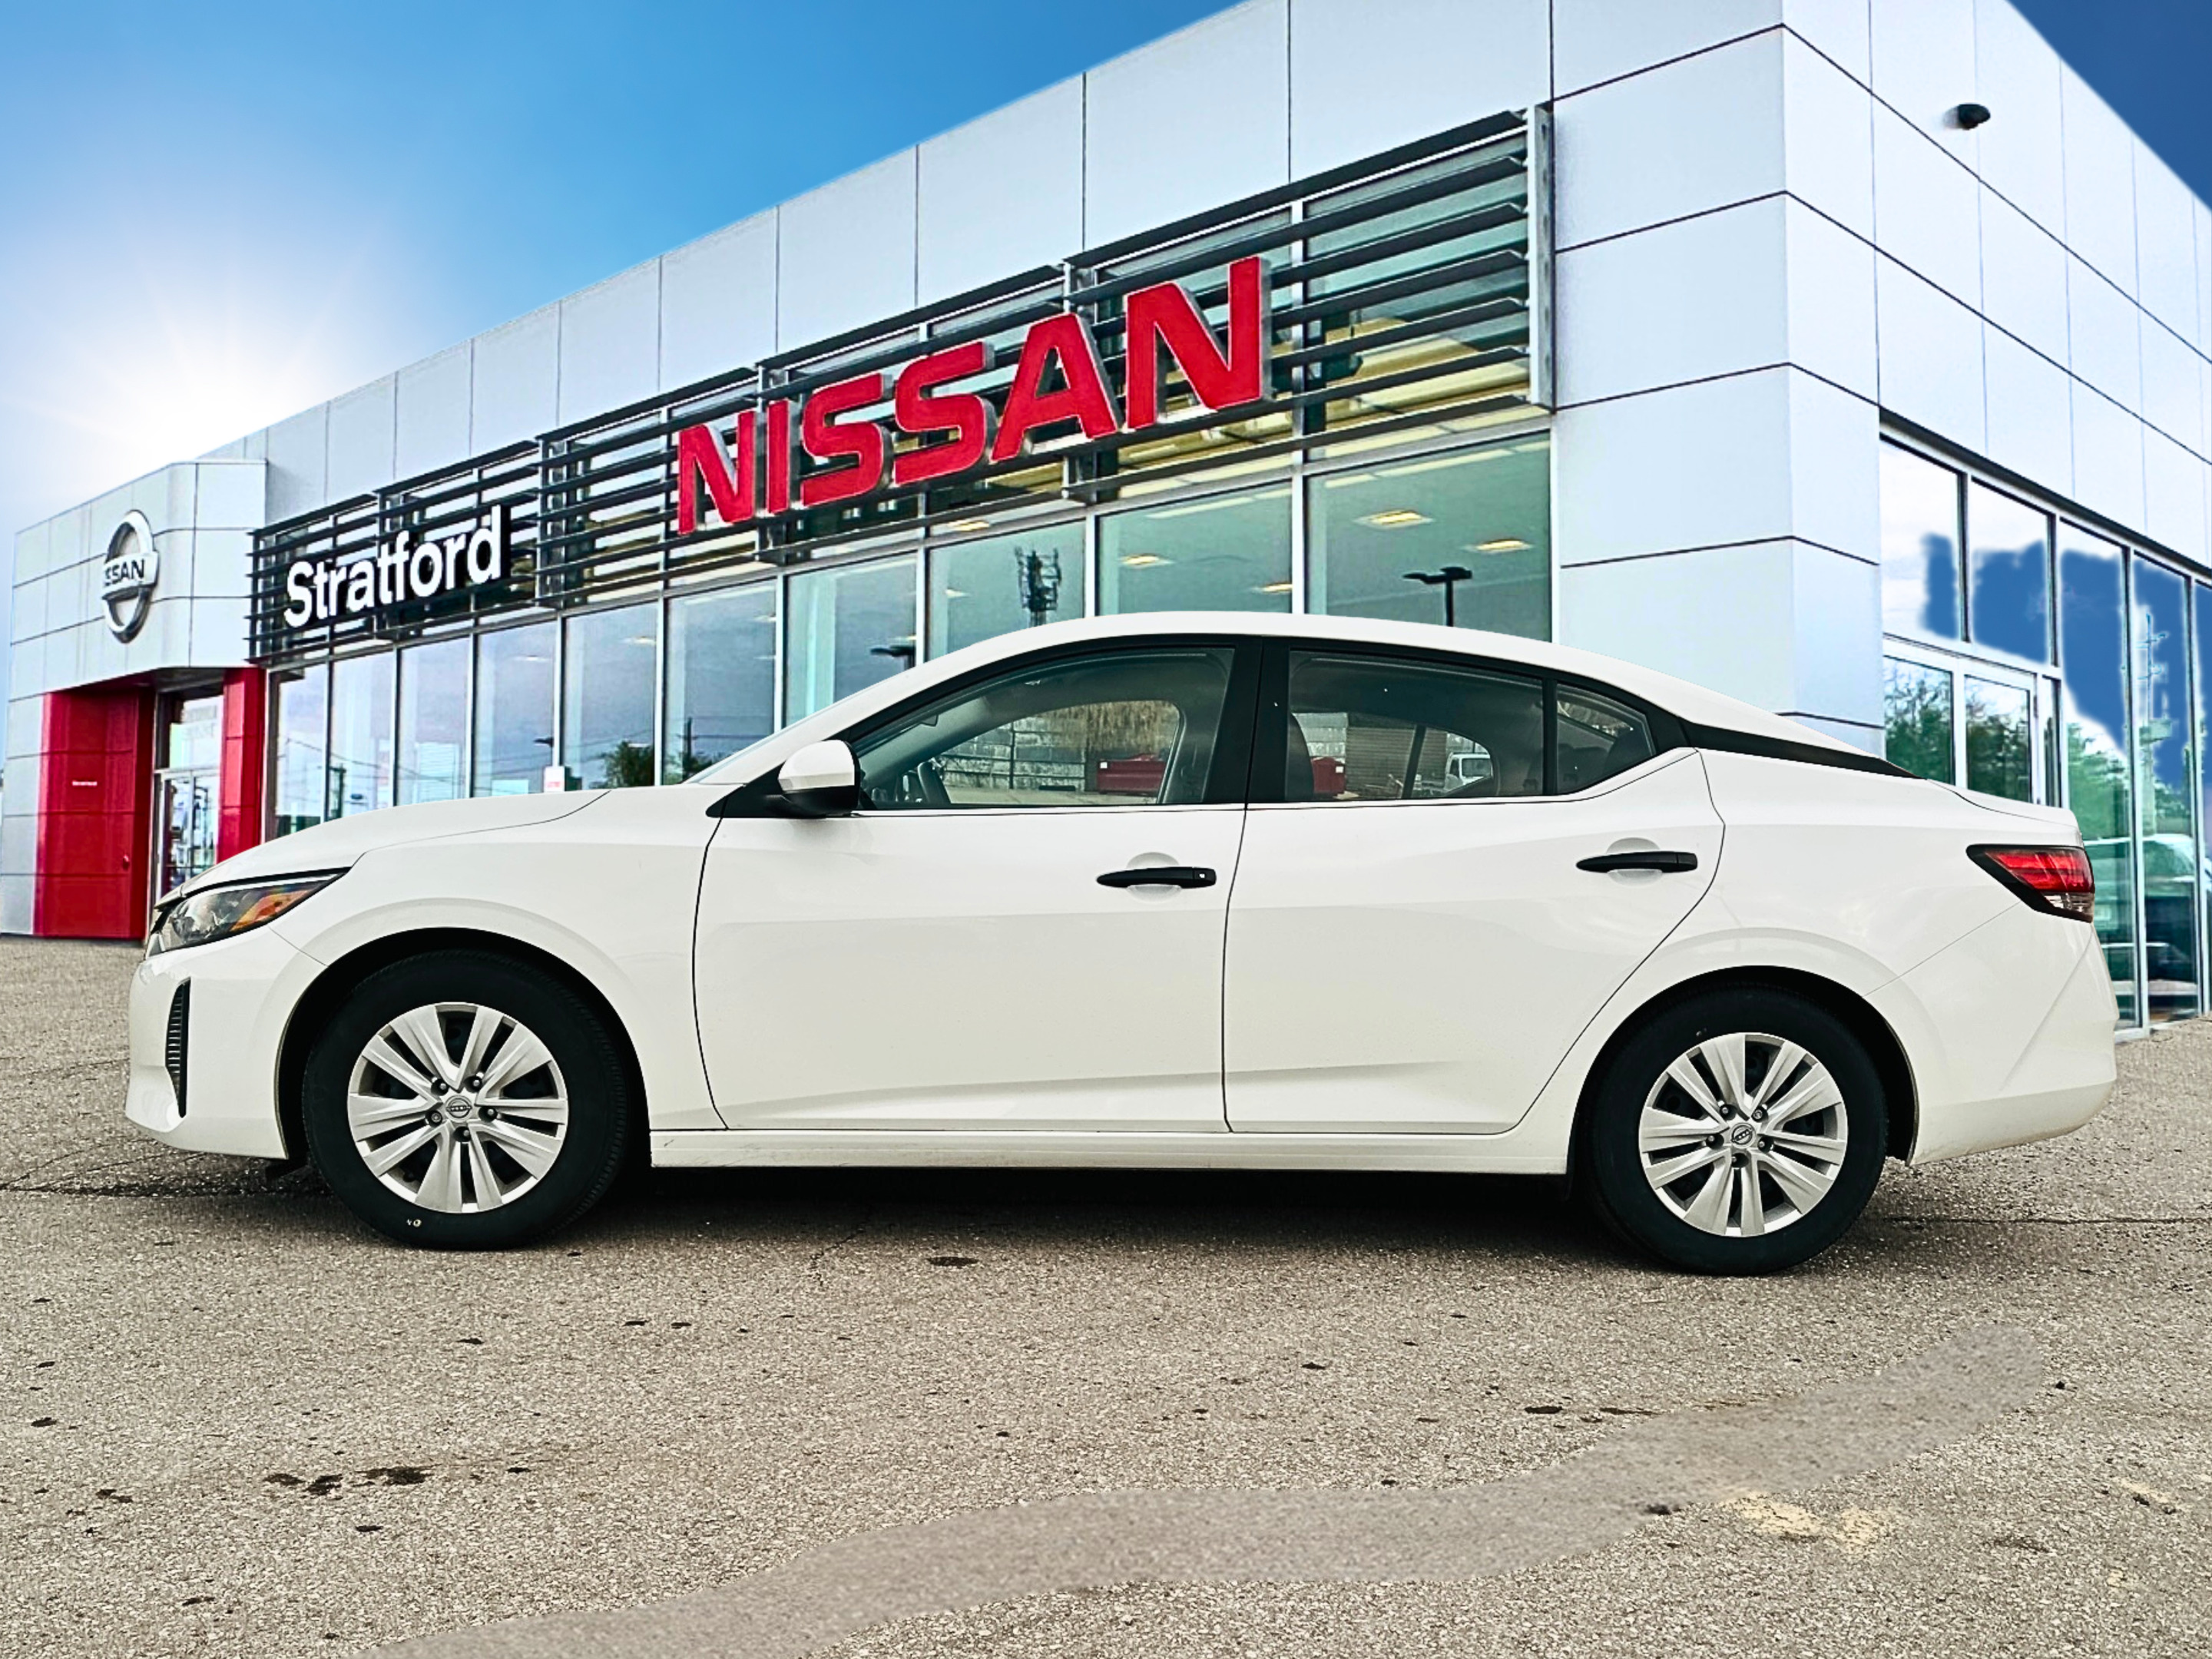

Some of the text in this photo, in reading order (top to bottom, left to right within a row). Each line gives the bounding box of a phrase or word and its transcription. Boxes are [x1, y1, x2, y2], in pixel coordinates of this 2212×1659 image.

[677, 256, 1266, 535] NISSAN
[104, 559, 145, 587] SSAN
[284, 505, 502, 628] Stratford
